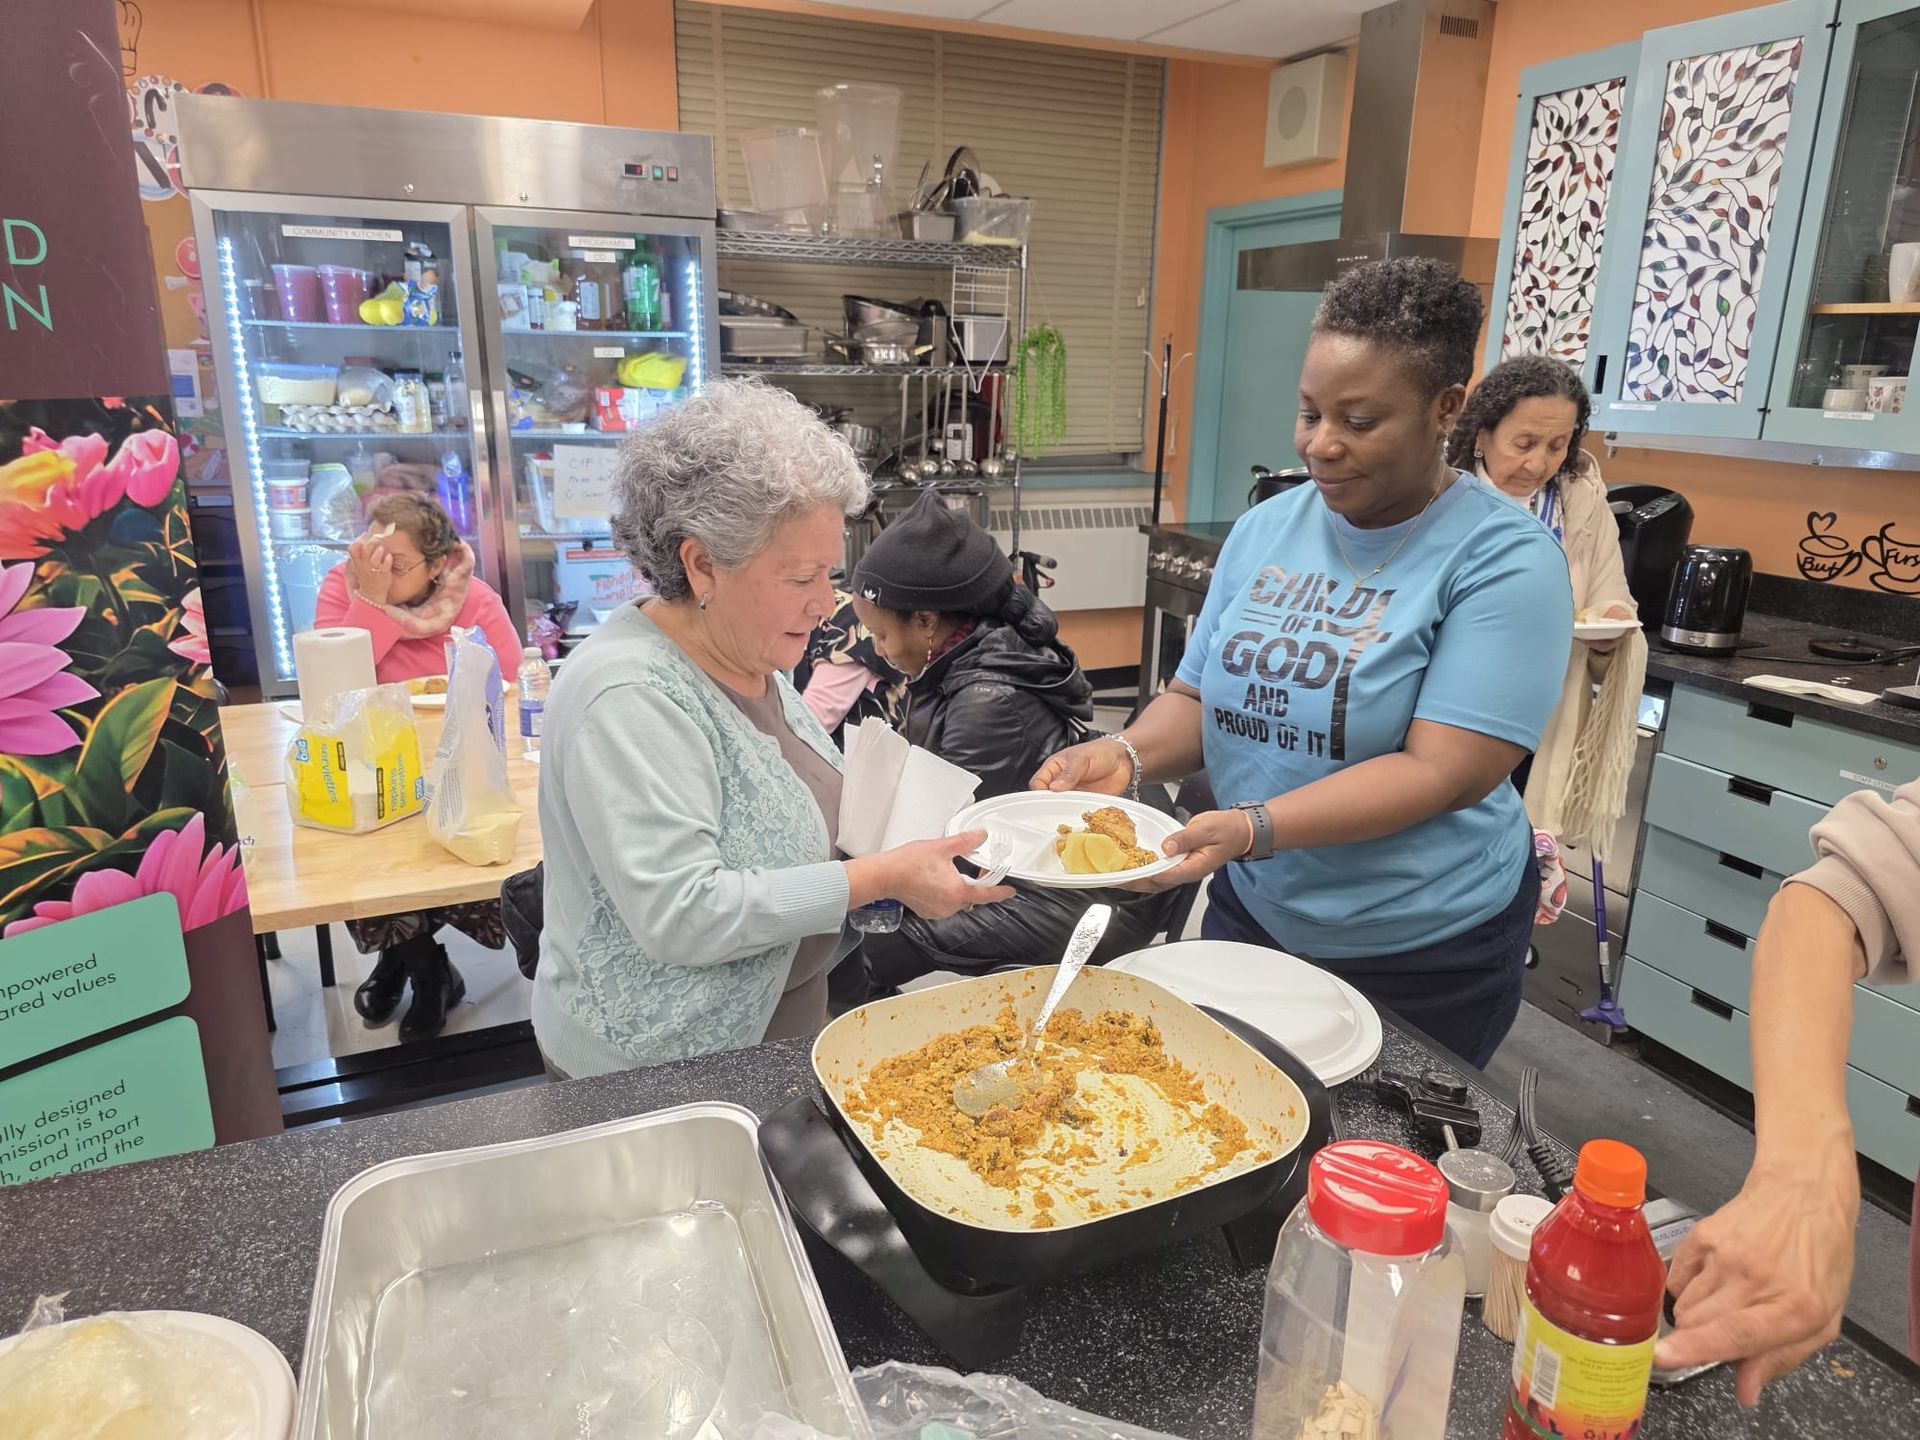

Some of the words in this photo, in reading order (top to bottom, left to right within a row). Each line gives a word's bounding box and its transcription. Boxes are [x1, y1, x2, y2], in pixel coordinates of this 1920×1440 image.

[292, 227, 349, 237] COMMUNITY
[352, 231, 392, 240] KITCHEN
[578, 239, 626, 248] PROGRAMS
[1803, 556, 1840, 577] But
[1250, 565, 1377, 620] CHILD
[1280, 613, 1312, 634] OF
[1222, 631, 1339, 690] GOD
[1243, 683, 1290, 718] AND
[1214, 707, 1270, 744] PROUD
[1277, 723, 1299, 751] OF
[1307, 730, 1326, 758] IT
[321, 743, 338, 803] serviettes
[52, 972, 117, 1001] values
[34, 1079, 127, 1128] designed
[77, 1118, 92, 1131] is
[98, 1107, 118, 1123] to
[29, 1142, 69, 1172] and
[75, 1115, 141, 1151] impart
[70, 1150, 108, 1175] and
[114, 1135, 145, 1155] the
